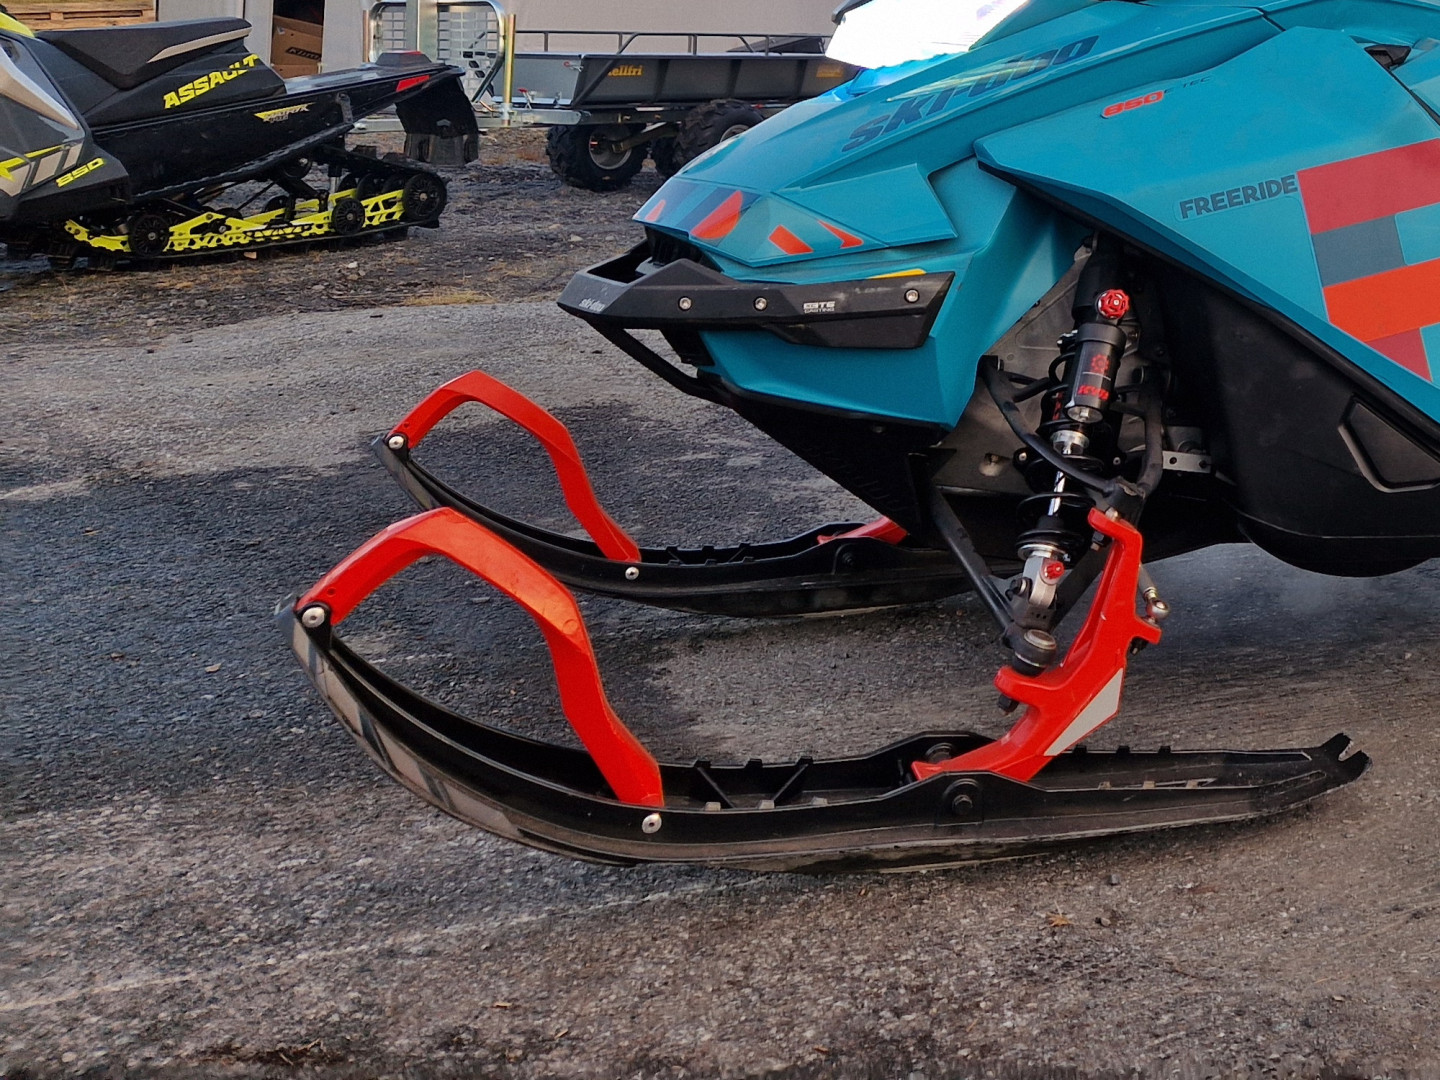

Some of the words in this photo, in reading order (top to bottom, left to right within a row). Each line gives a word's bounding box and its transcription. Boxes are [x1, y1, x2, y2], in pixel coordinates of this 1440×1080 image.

[163, 53, 260, 109] ASSAULT
[1103, 90, 1164, 118] 850
[55, 157, 104, 188] 850
[1179, 174, 1299, 220] FREERIDE
